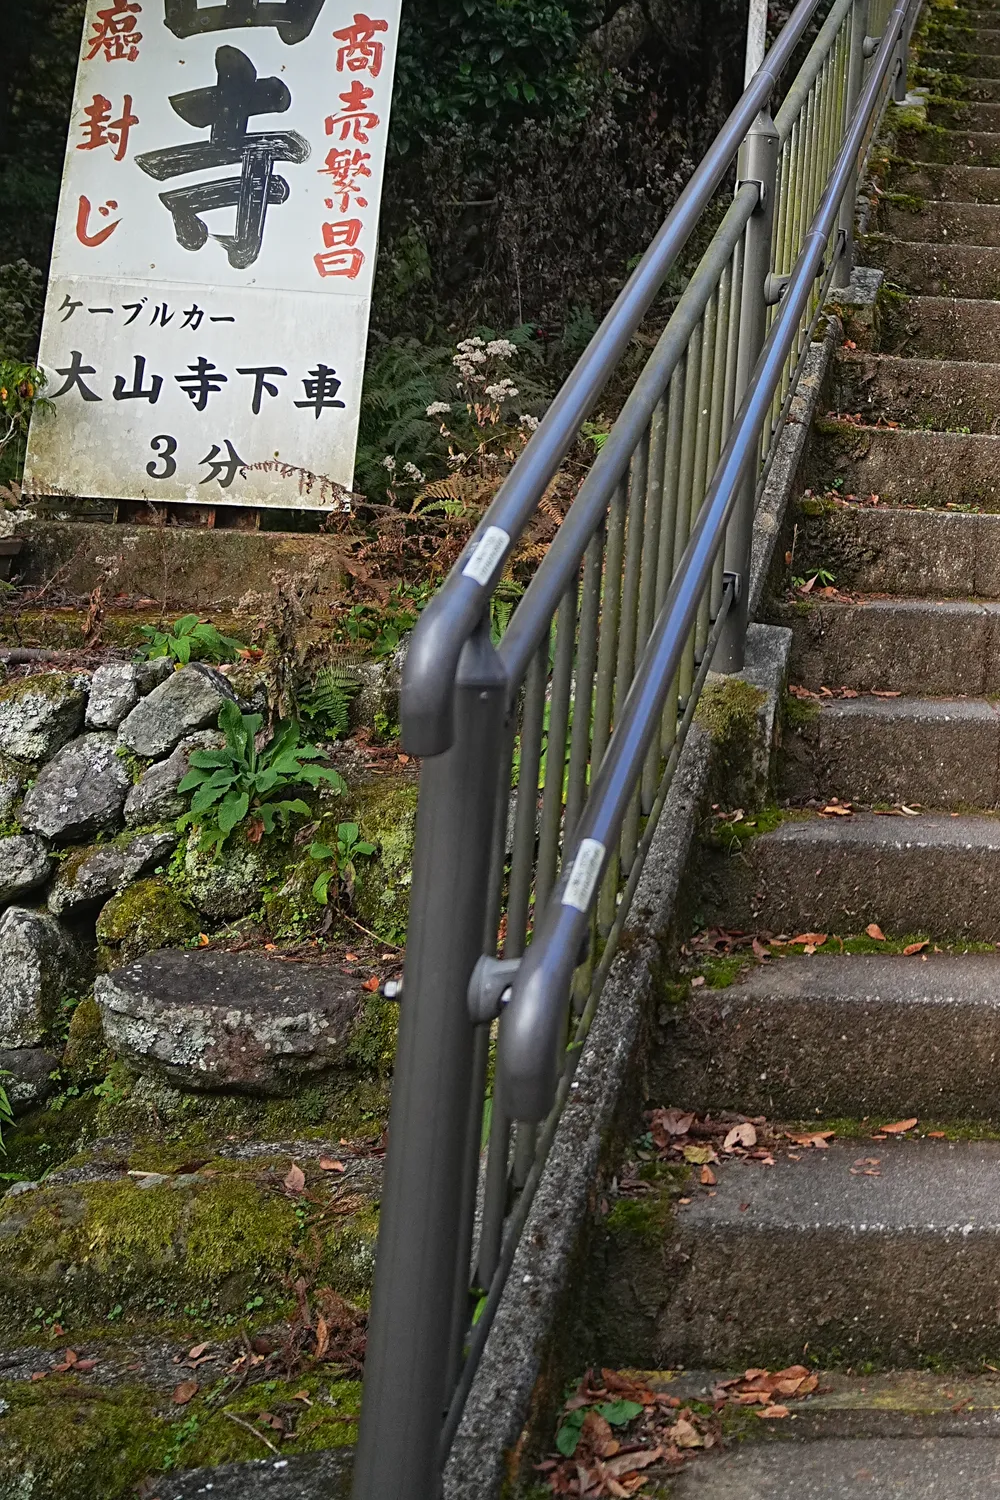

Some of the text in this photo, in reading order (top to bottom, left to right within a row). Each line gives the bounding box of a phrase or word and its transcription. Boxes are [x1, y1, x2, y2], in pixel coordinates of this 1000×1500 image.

[58, 294, 235, 330] ケーブルカー
[49, 350, 346, 420] 大山寺下車
